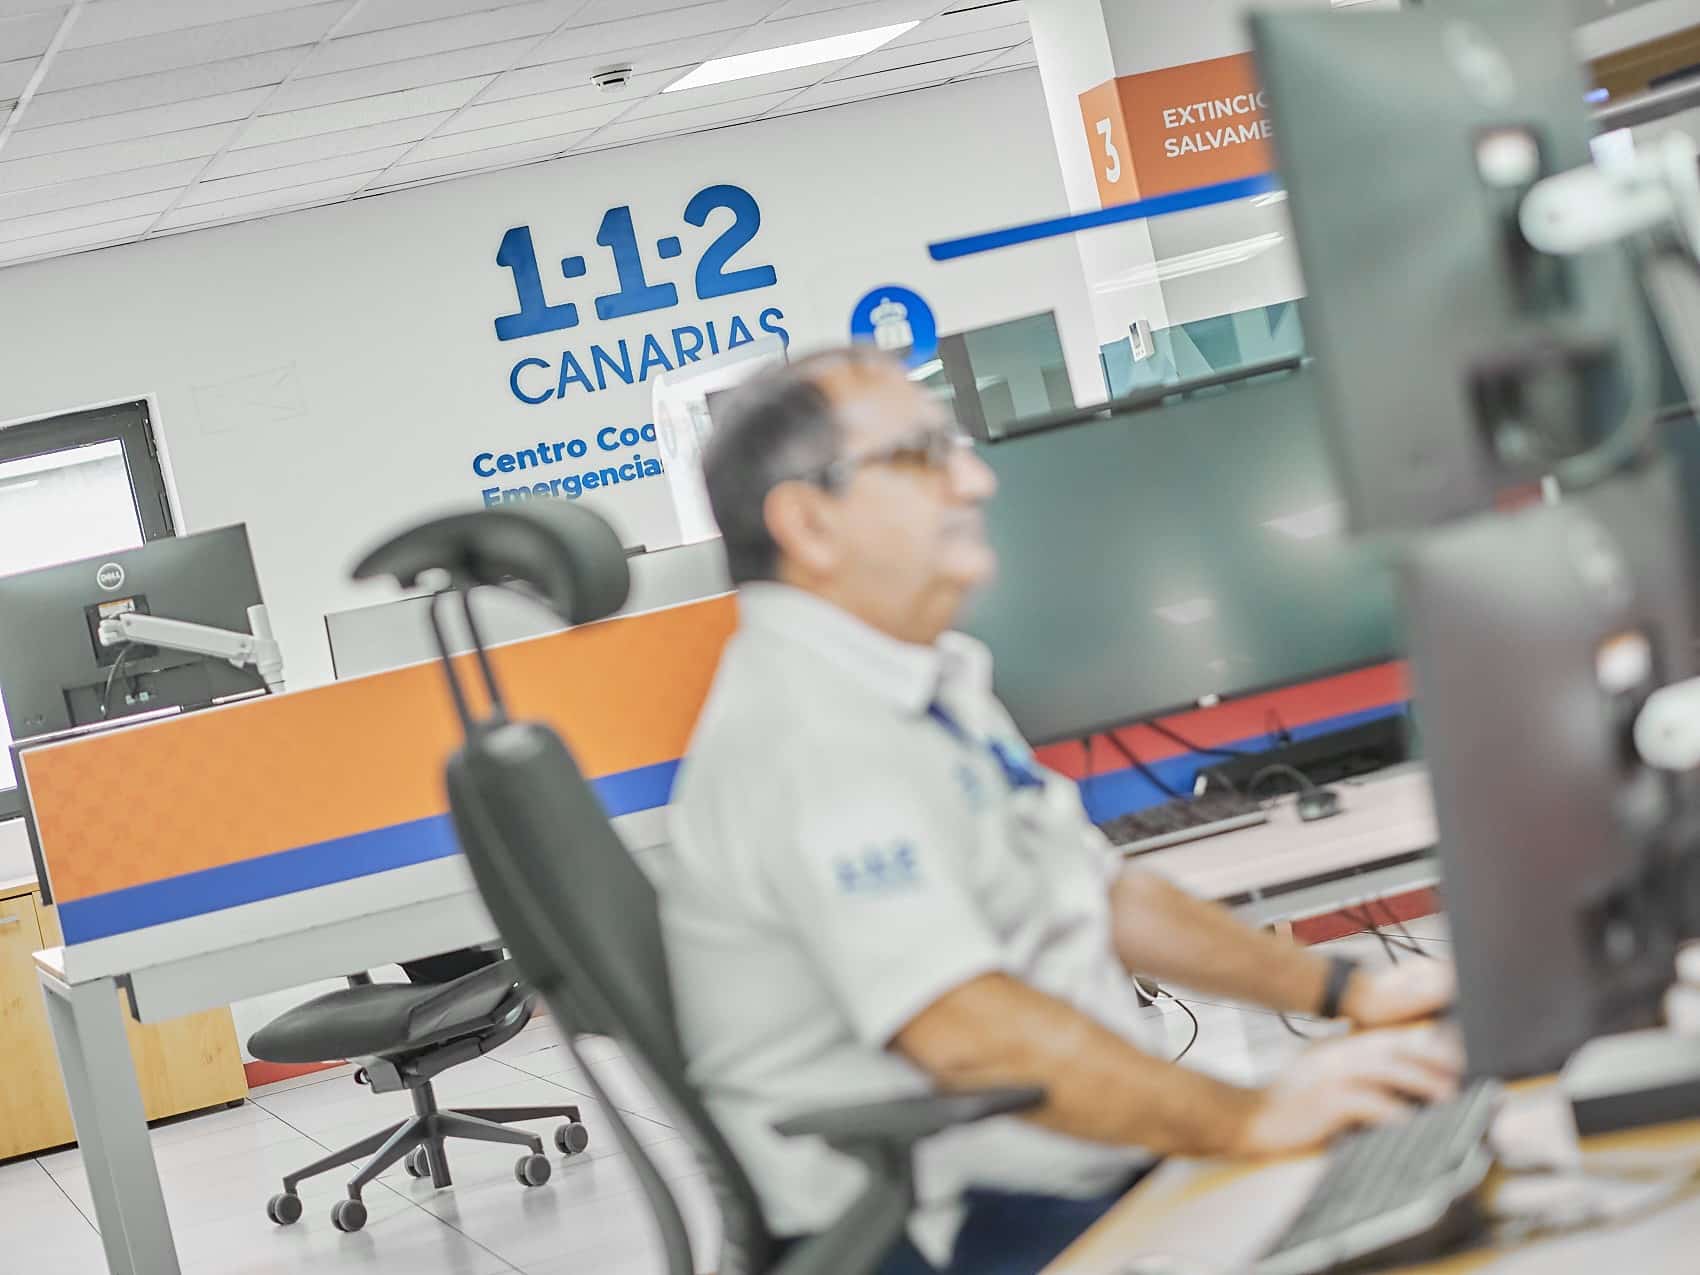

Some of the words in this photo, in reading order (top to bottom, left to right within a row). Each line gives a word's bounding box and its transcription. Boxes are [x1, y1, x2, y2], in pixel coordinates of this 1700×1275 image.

[1095, 117, 1121, 184] 3
[1163, 119, 1273, 158] SALVAME
[509, 307, 791, 405] CANARIAS
[472, 438, 588, 477] Centro
[481, 454, 665, 508] Emergencia
